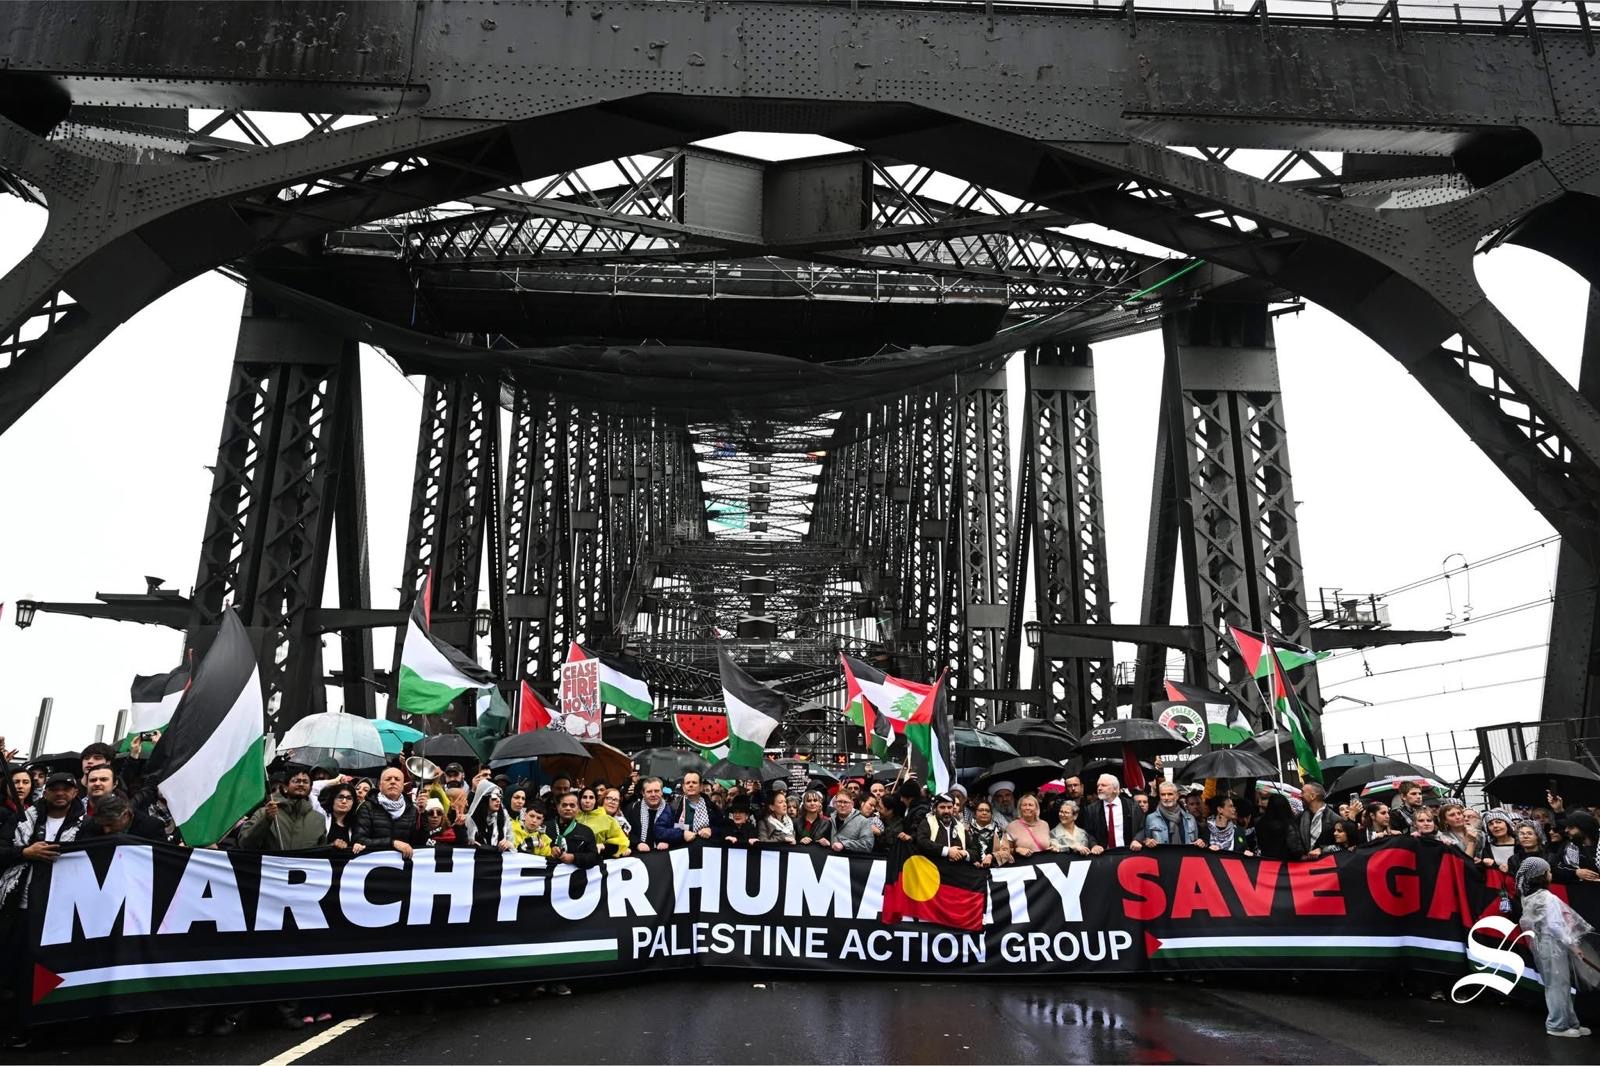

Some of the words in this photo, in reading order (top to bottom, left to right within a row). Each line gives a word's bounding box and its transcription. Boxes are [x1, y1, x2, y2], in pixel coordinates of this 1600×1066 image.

[563, 662, 597, 680] CEASE
[563, 676, 597, 699] FIRE
[698, 705, 727, 713] PALEST
[1161, 754, 1178, 762] STOP
[40, 845, 476, 946] MARCH
[497, 851, 657, 921] FOR
[1117, 854, 1346, 921] SAVE
[632, 923, 828, 959] PALESTINE
[839, 929, 986, 963] ACTION
[1001, 931, 1132, 963] GROUP
